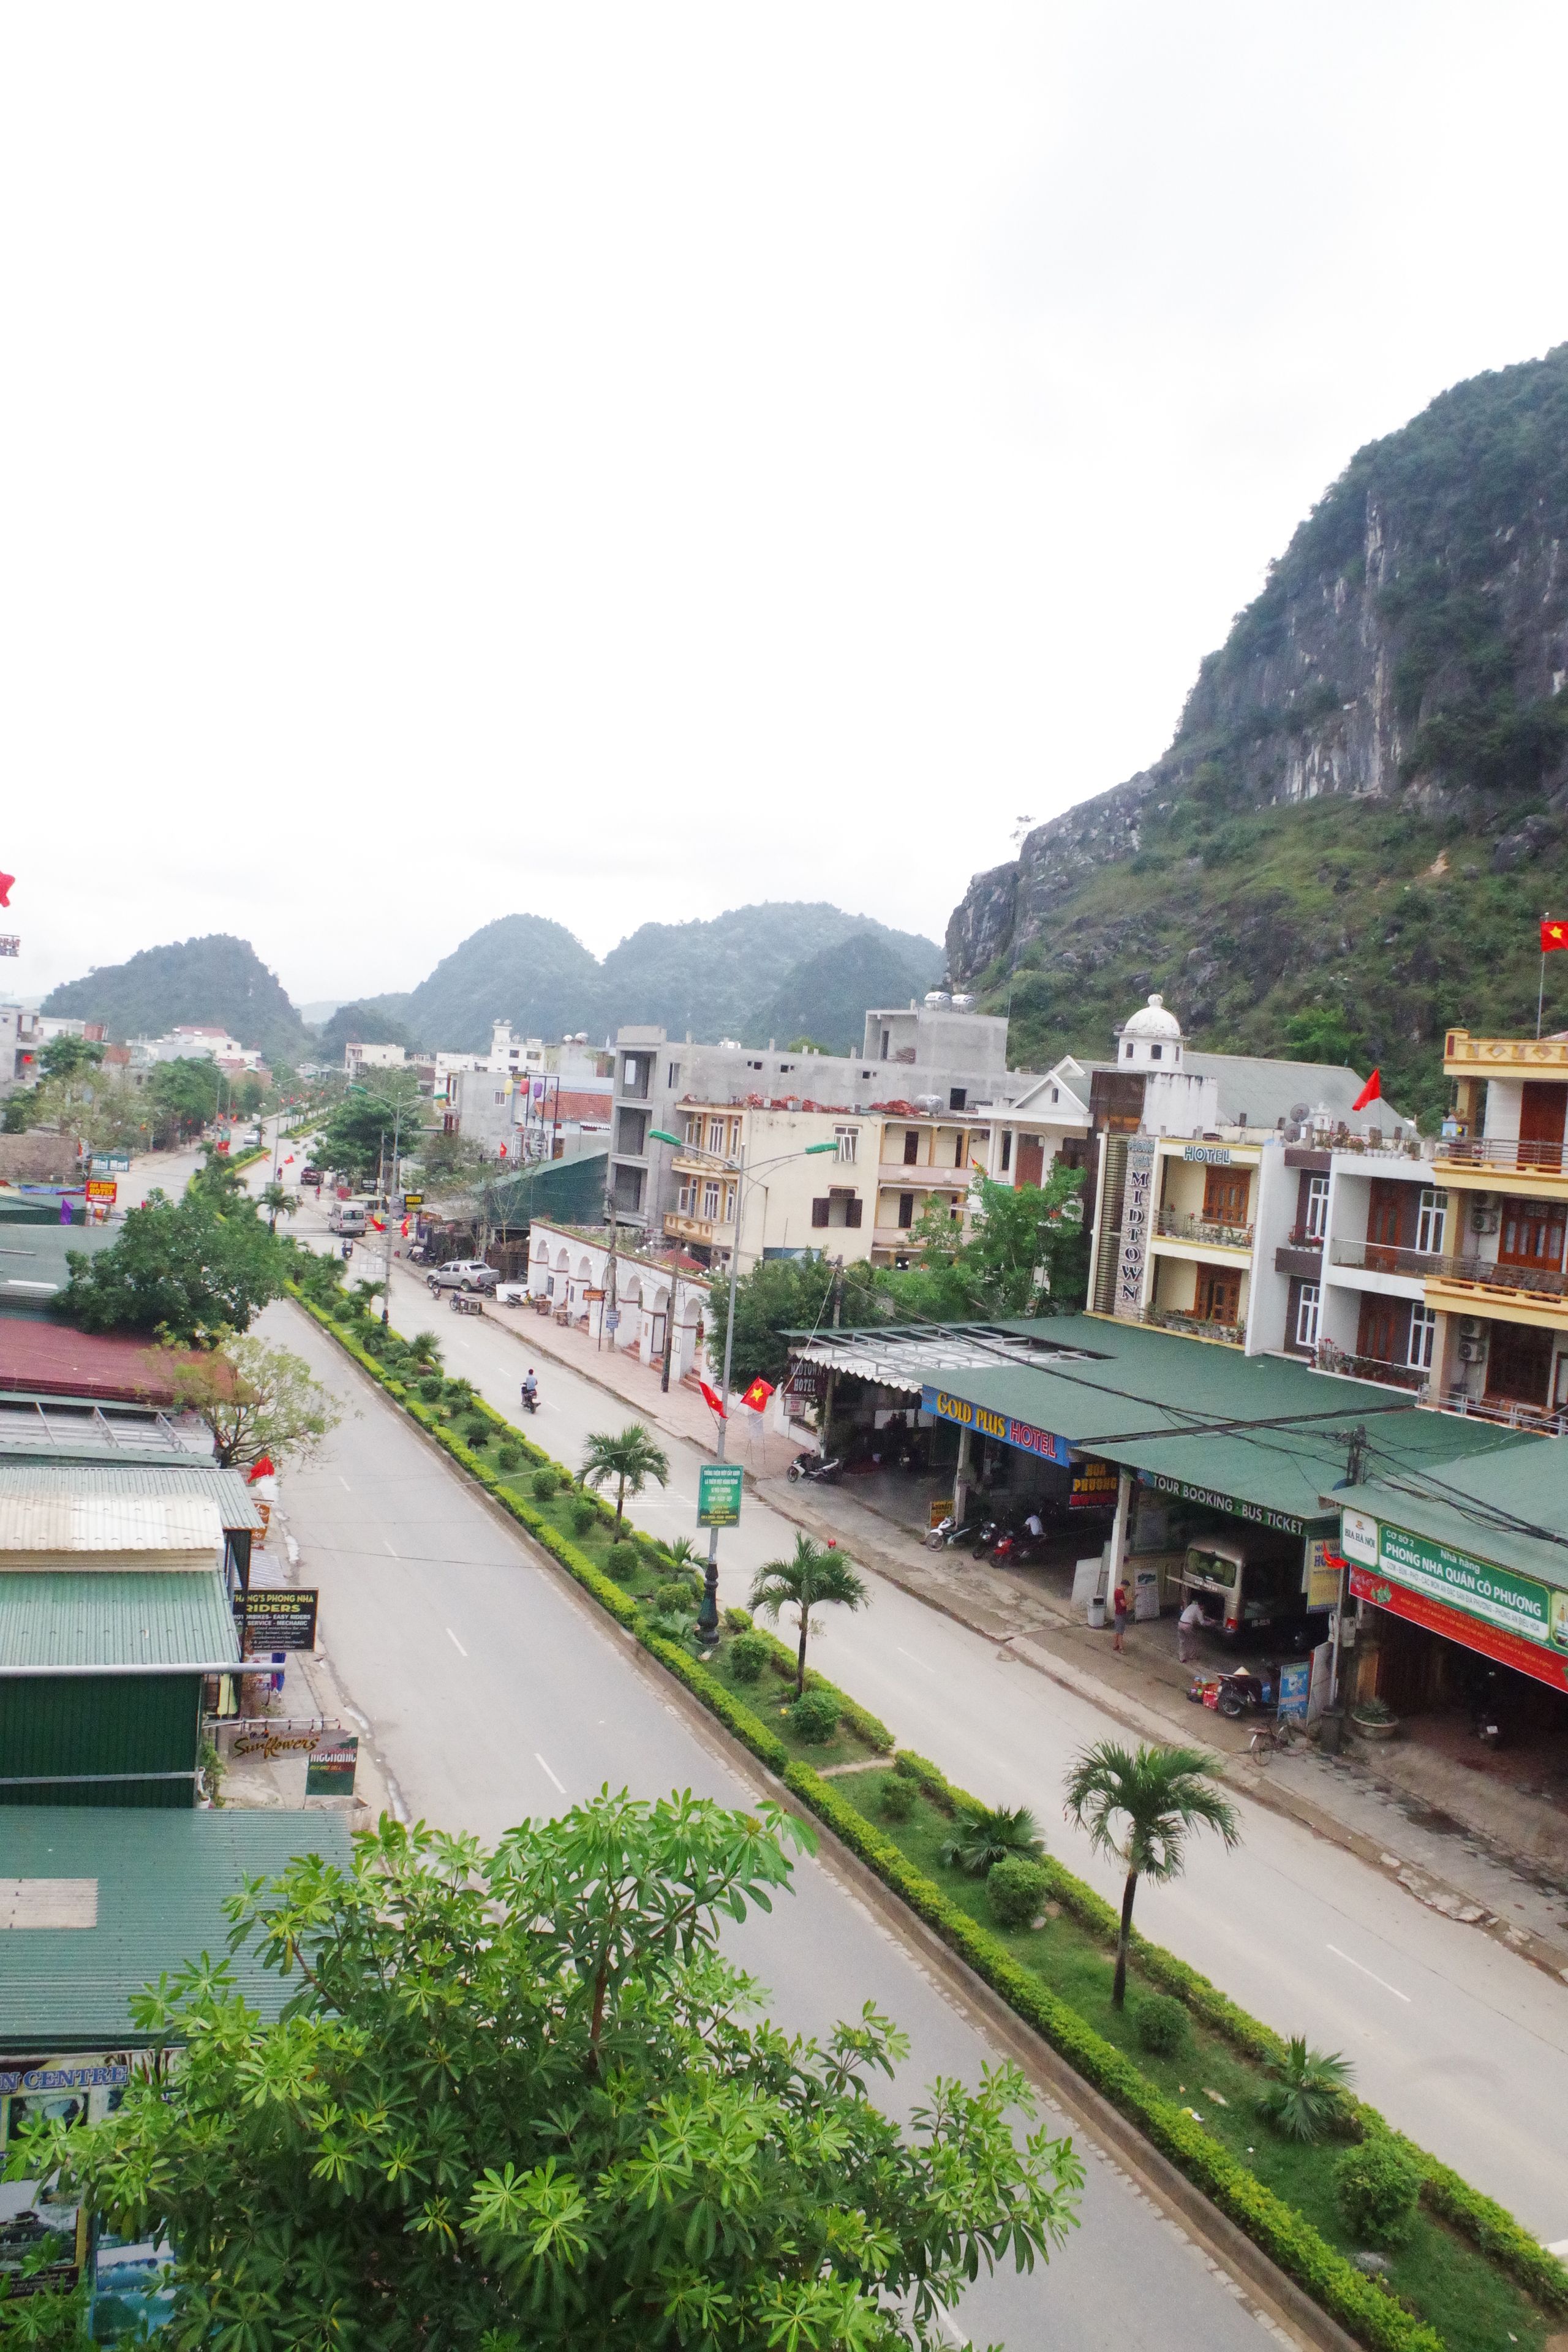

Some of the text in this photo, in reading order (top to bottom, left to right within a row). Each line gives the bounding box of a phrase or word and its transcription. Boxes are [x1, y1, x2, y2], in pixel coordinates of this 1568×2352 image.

[1128, 1140, 1155, 1153] PHONG
[1183, 1146, 1231, 1165] HOTEL
[92, 1158, 108, 1170] Mini
[1121, 1170, 1148, 1301] MIDTOWN
[793, 1378, 816, 1392] HOTEL
[937, 1392, 972, 1423] GOLD
[976, 1408, 1006, 1438] PLUS
[1010, 1420, 1057, 1458] HOTEL
[1154, 1476, 1303, 1534] TOUR BOOKING BUS TICKET
[1344, 1528, 1355, 1540] BIA
[1355, 1532, 1365, 1544] HÀ
[1410, 1539, 1414, 1547] 2
[1441, 1549, 1480, 1575] Nhà hàng
[1385, 1542, 1421, 1567] PHONG
[1422, 1556, 1444, 1577] NHA
[1446, 1567, 1475, 1589] QUÁN
[1477, 1580, 1492, 1596] CÔ
[1493, 1586, 1542, 1617] PHƯỢNG
[246, 1604, 301, 1613] RIDERS
[232, 1736, 321, 1759] Sunflowers
[23, 2065, 129, 2090] CENTRE
